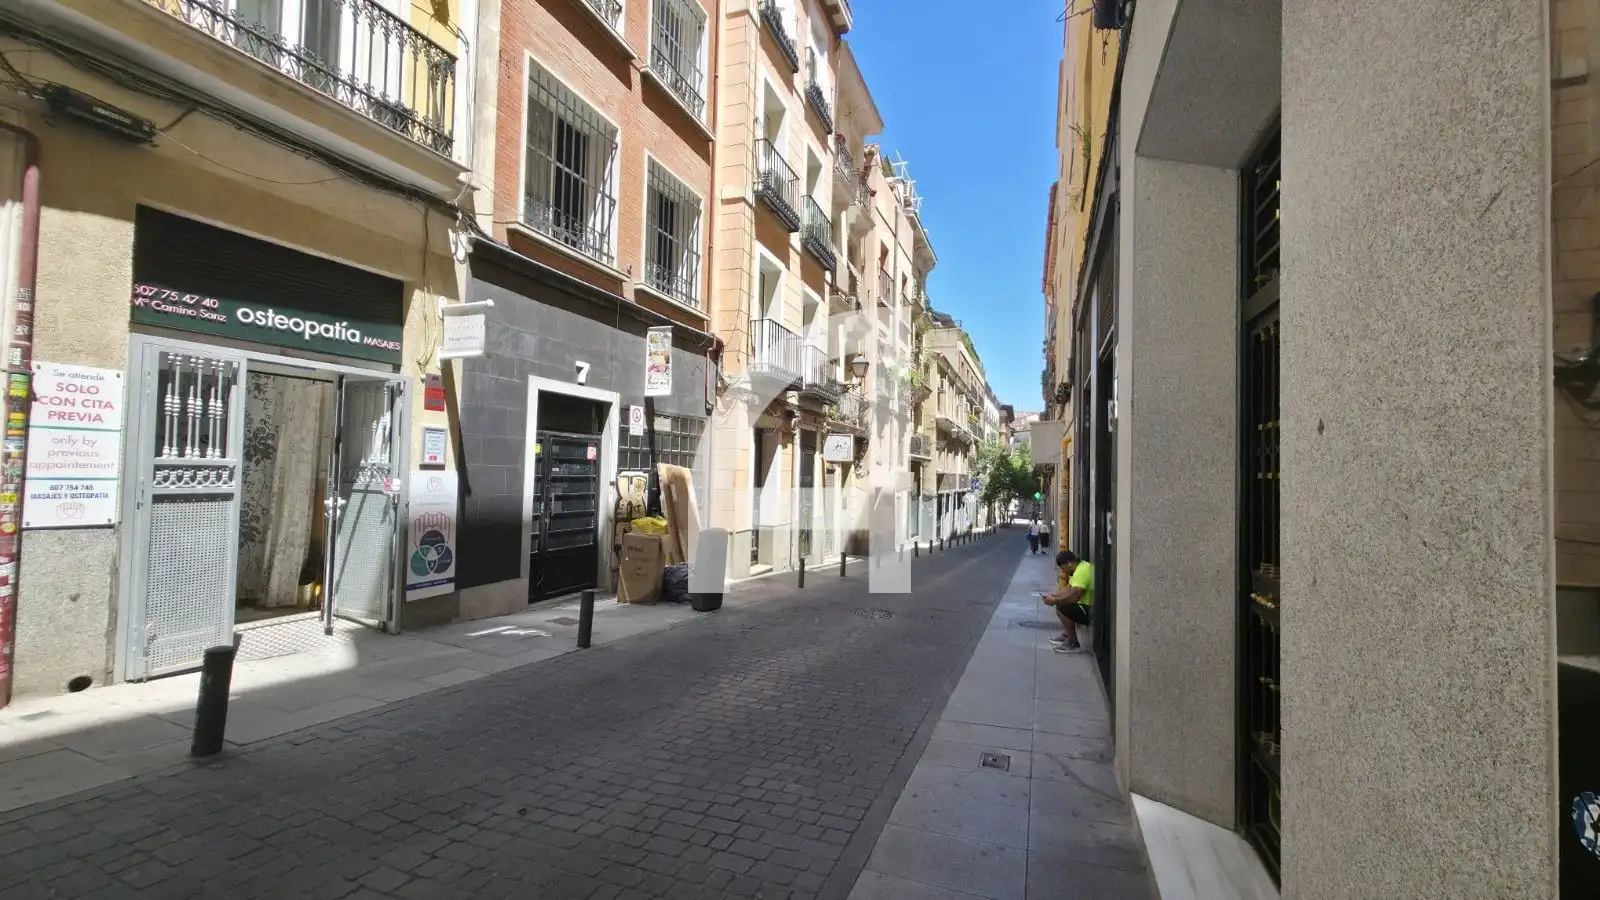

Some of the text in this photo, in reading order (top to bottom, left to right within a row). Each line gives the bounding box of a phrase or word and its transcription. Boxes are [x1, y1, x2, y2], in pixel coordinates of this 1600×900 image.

[161, 289, 178, 301] 75
[182, 294, 200, 304] 47
[201, 298, 219, 309] 40
[151, 300, 197, 316] Camino
[199, 308, 227, 321] Sanz
[363, 336, 401, 351] MASAJES
[53, 368, 105, 381] Se atiende
[575, 361, 591, 384] 7
[55, 382, 100, 395] SOLO
[38, 395, 114, 410] CON CITA
[47, 411, 104, 423] PREVIA
[51, 435, 98, 448] only by
[47, 447, 100, 459] previous
[30, 492, 63, 500] MASAJES
